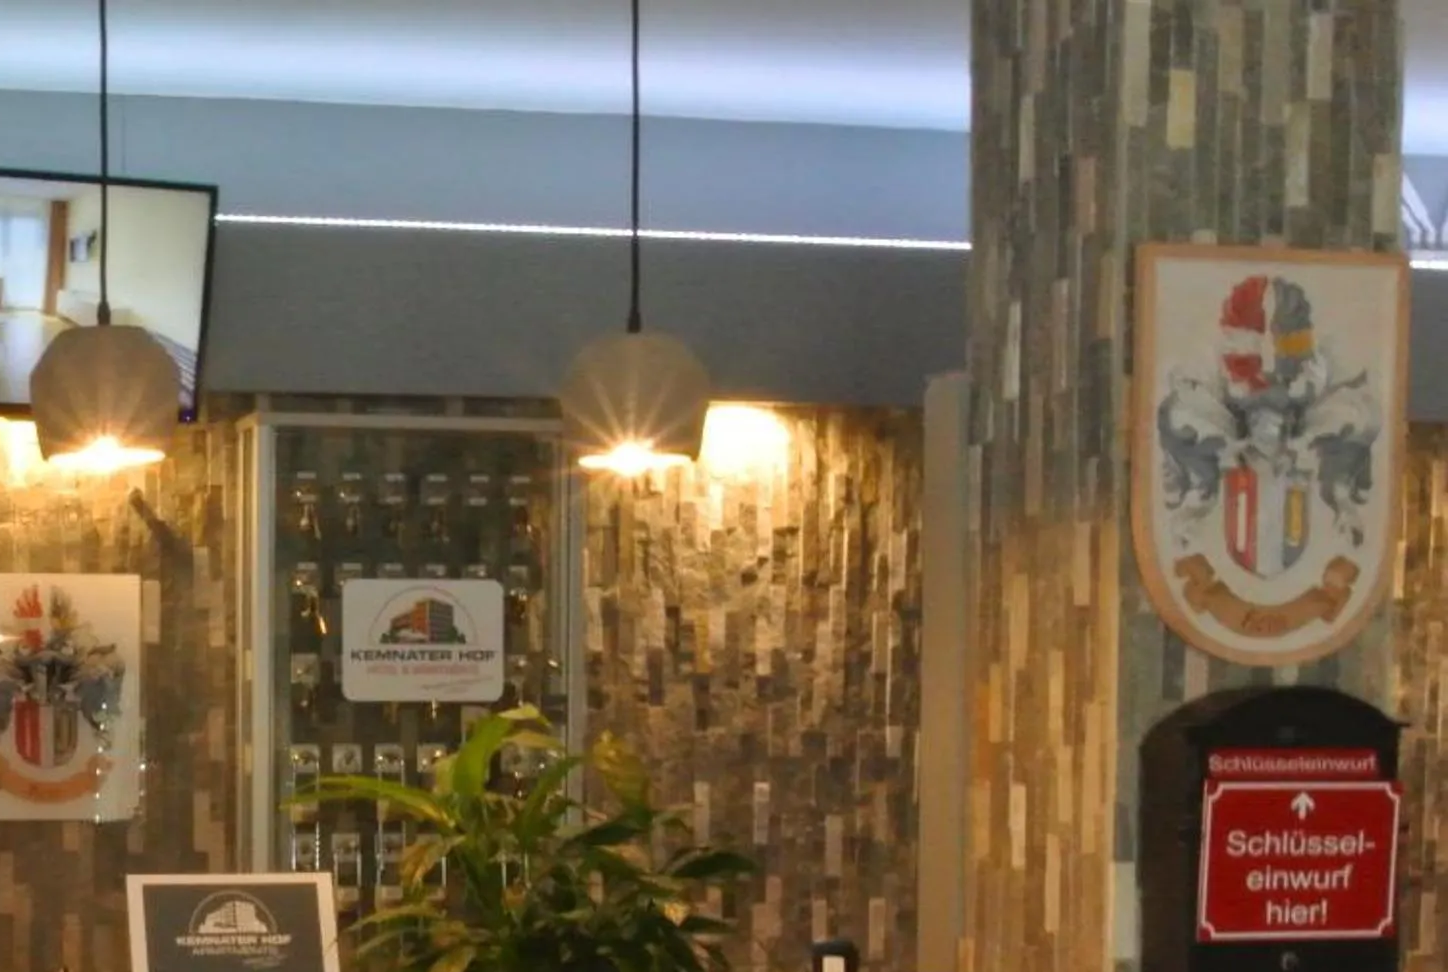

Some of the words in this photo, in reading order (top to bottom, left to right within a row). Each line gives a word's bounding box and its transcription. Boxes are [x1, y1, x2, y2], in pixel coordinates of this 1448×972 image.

[350, 649, 453, 662] KEMNATER
[458, 649, 495, 662] HOF
[1208, 754, 1376, 774] Schlüsseleinwurf
[1226, 829, 1375, 858] Schlüssel-
[1245, 863, 1355, 890] einwurf
[1265, 899, 1328, 926] hier!
